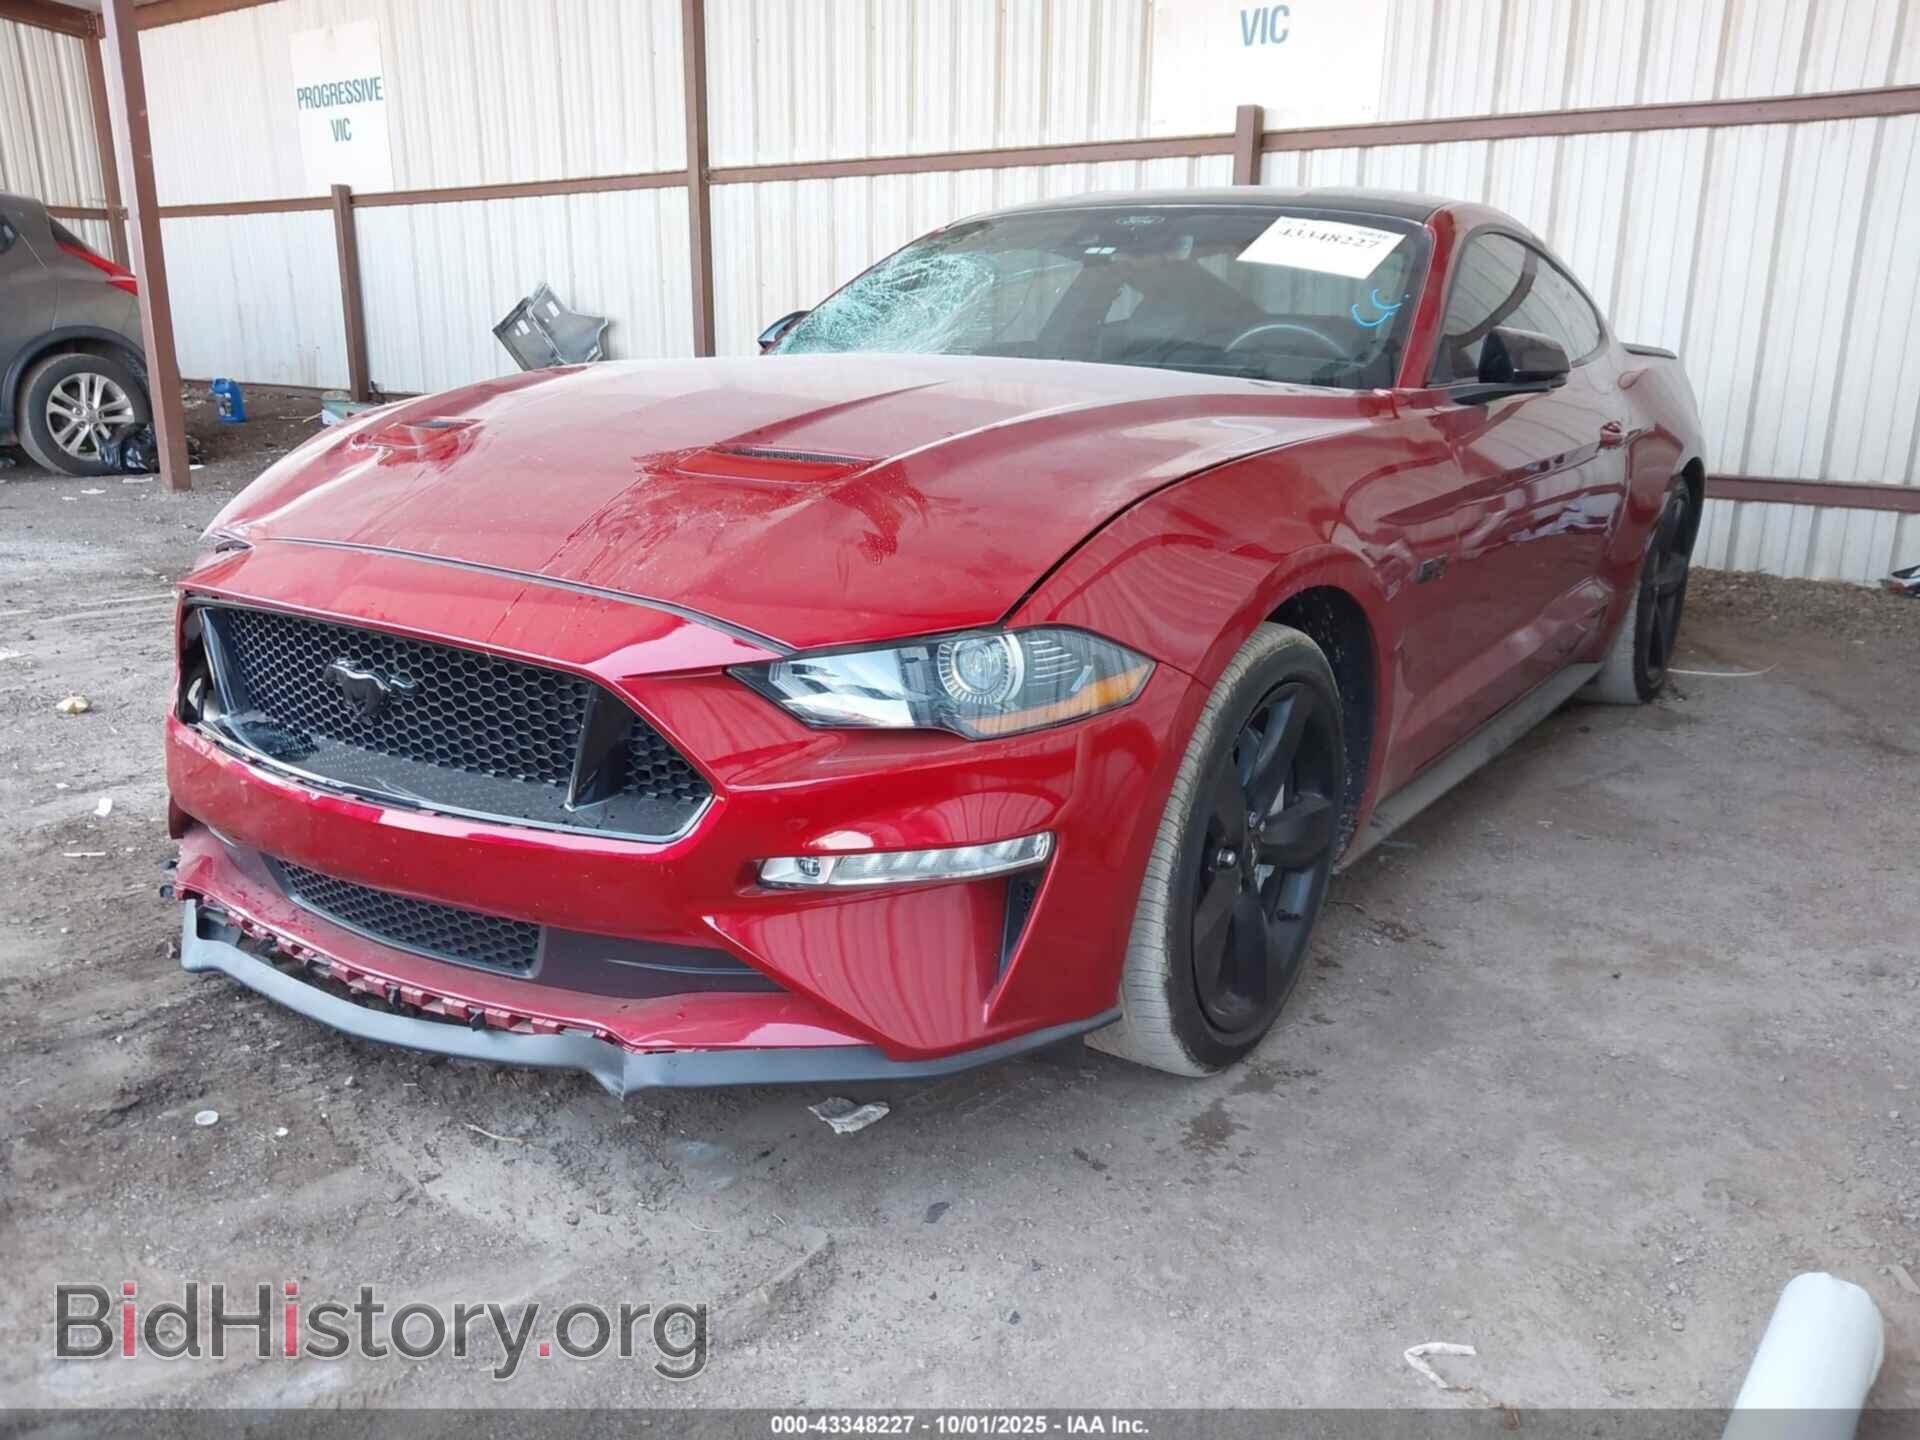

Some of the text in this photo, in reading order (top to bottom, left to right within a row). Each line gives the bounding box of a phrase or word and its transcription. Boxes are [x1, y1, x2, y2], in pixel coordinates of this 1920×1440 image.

[1240, 4, 1290, 47] VIC
[296, 76, 384, 110] PROGRESSIVE
[330, 117, 352, 142] VIC
